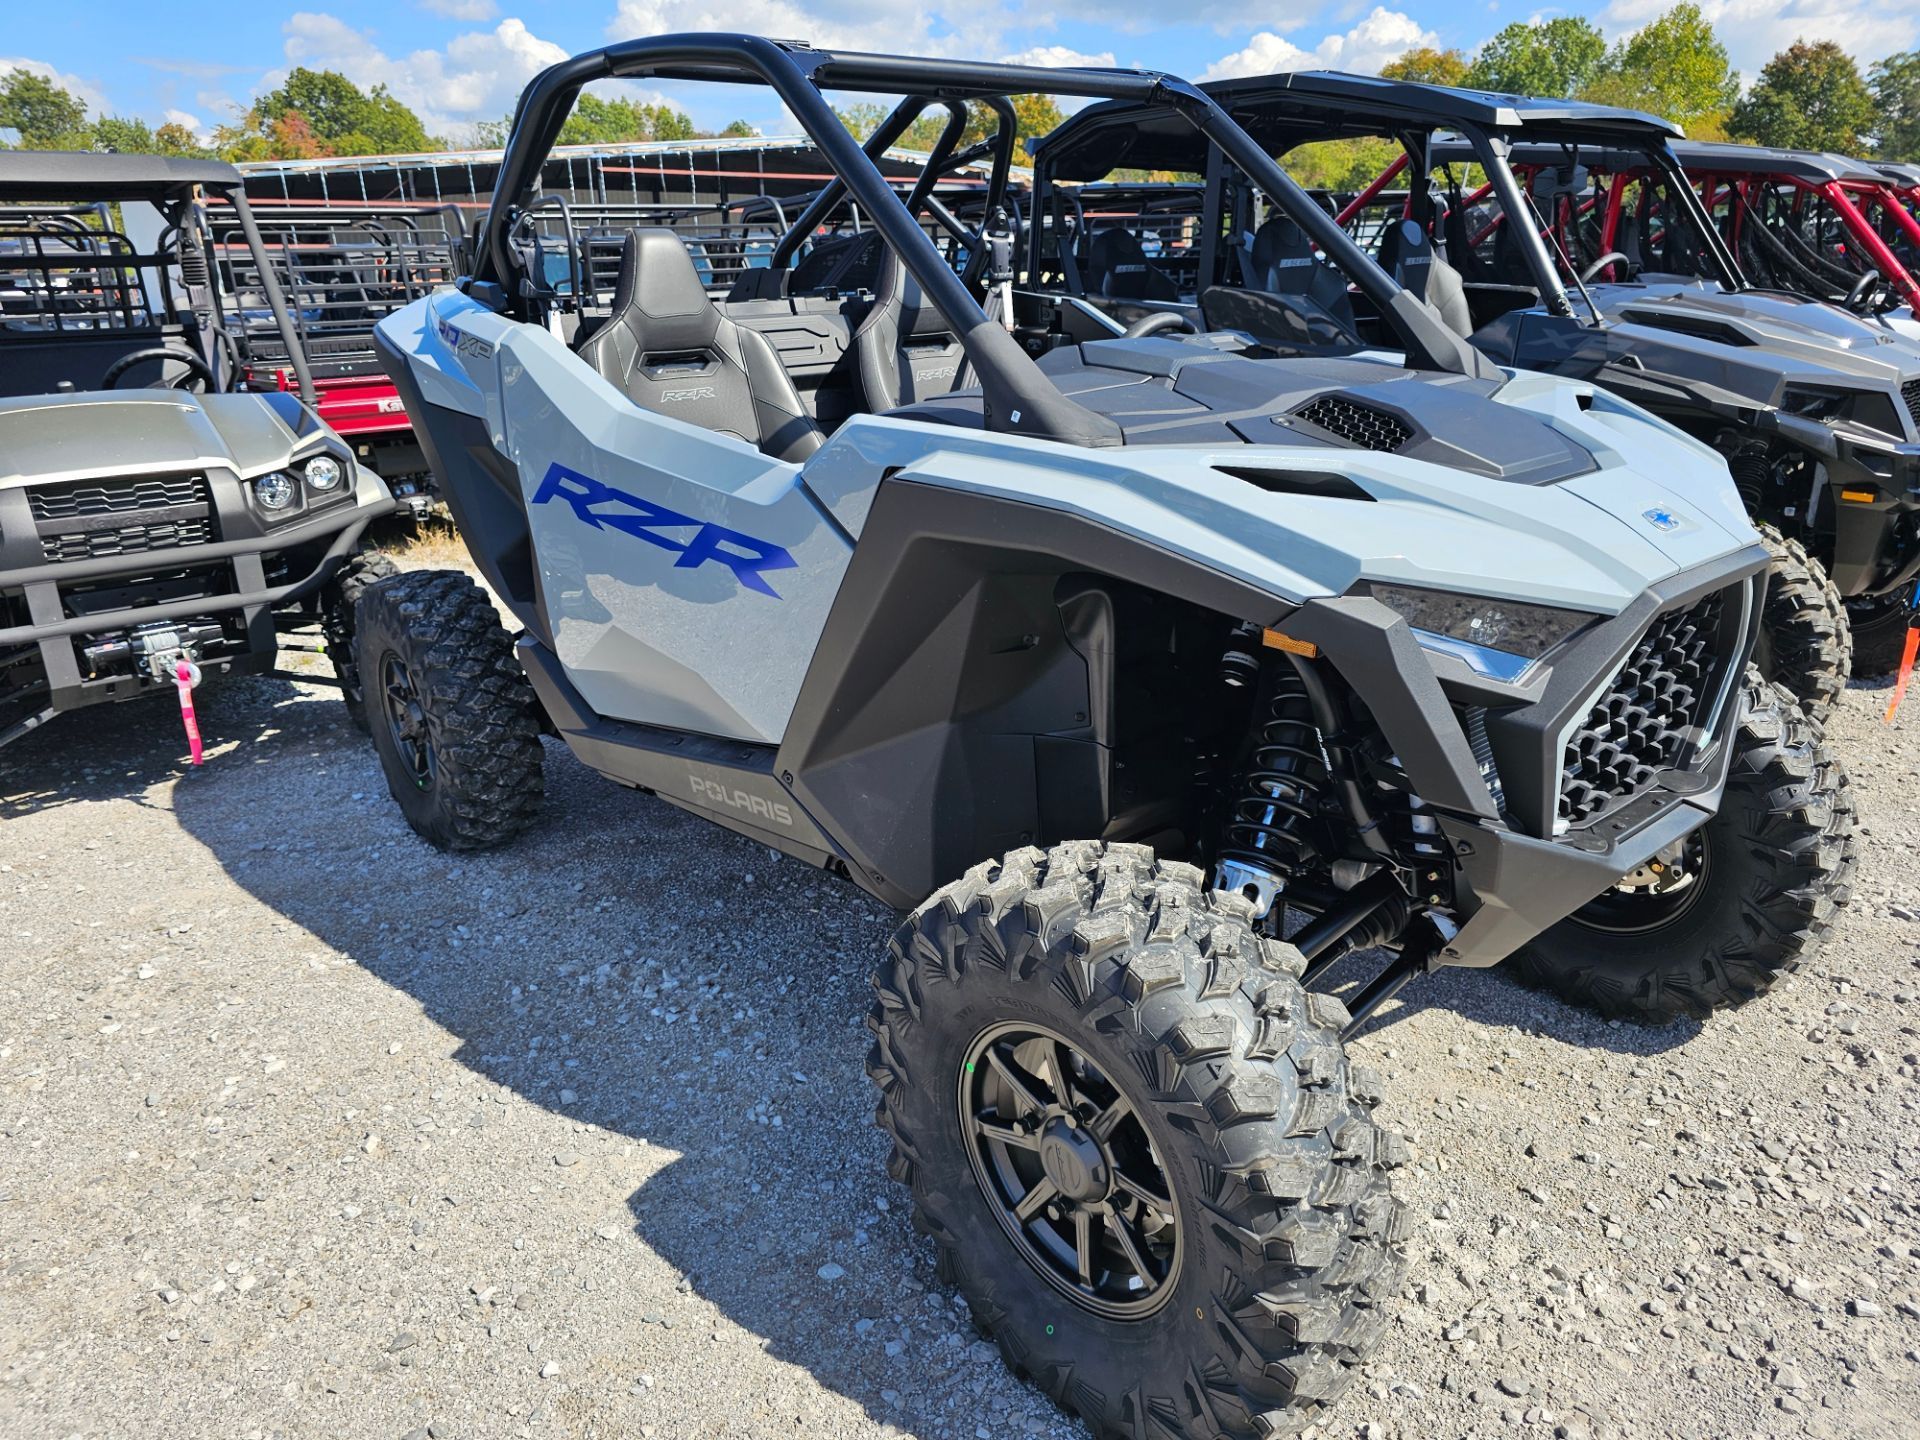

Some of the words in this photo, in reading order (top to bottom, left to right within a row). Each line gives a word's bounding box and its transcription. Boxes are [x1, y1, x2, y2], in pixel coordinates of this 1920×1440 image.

[458, 331, 494, 360] XP
[916, 366, 956, 382] RZR
[660, 386, 717, 402] RZR
[531, 462, 799, 601] RZR
[688, 774, 793, 826] POLARIS
